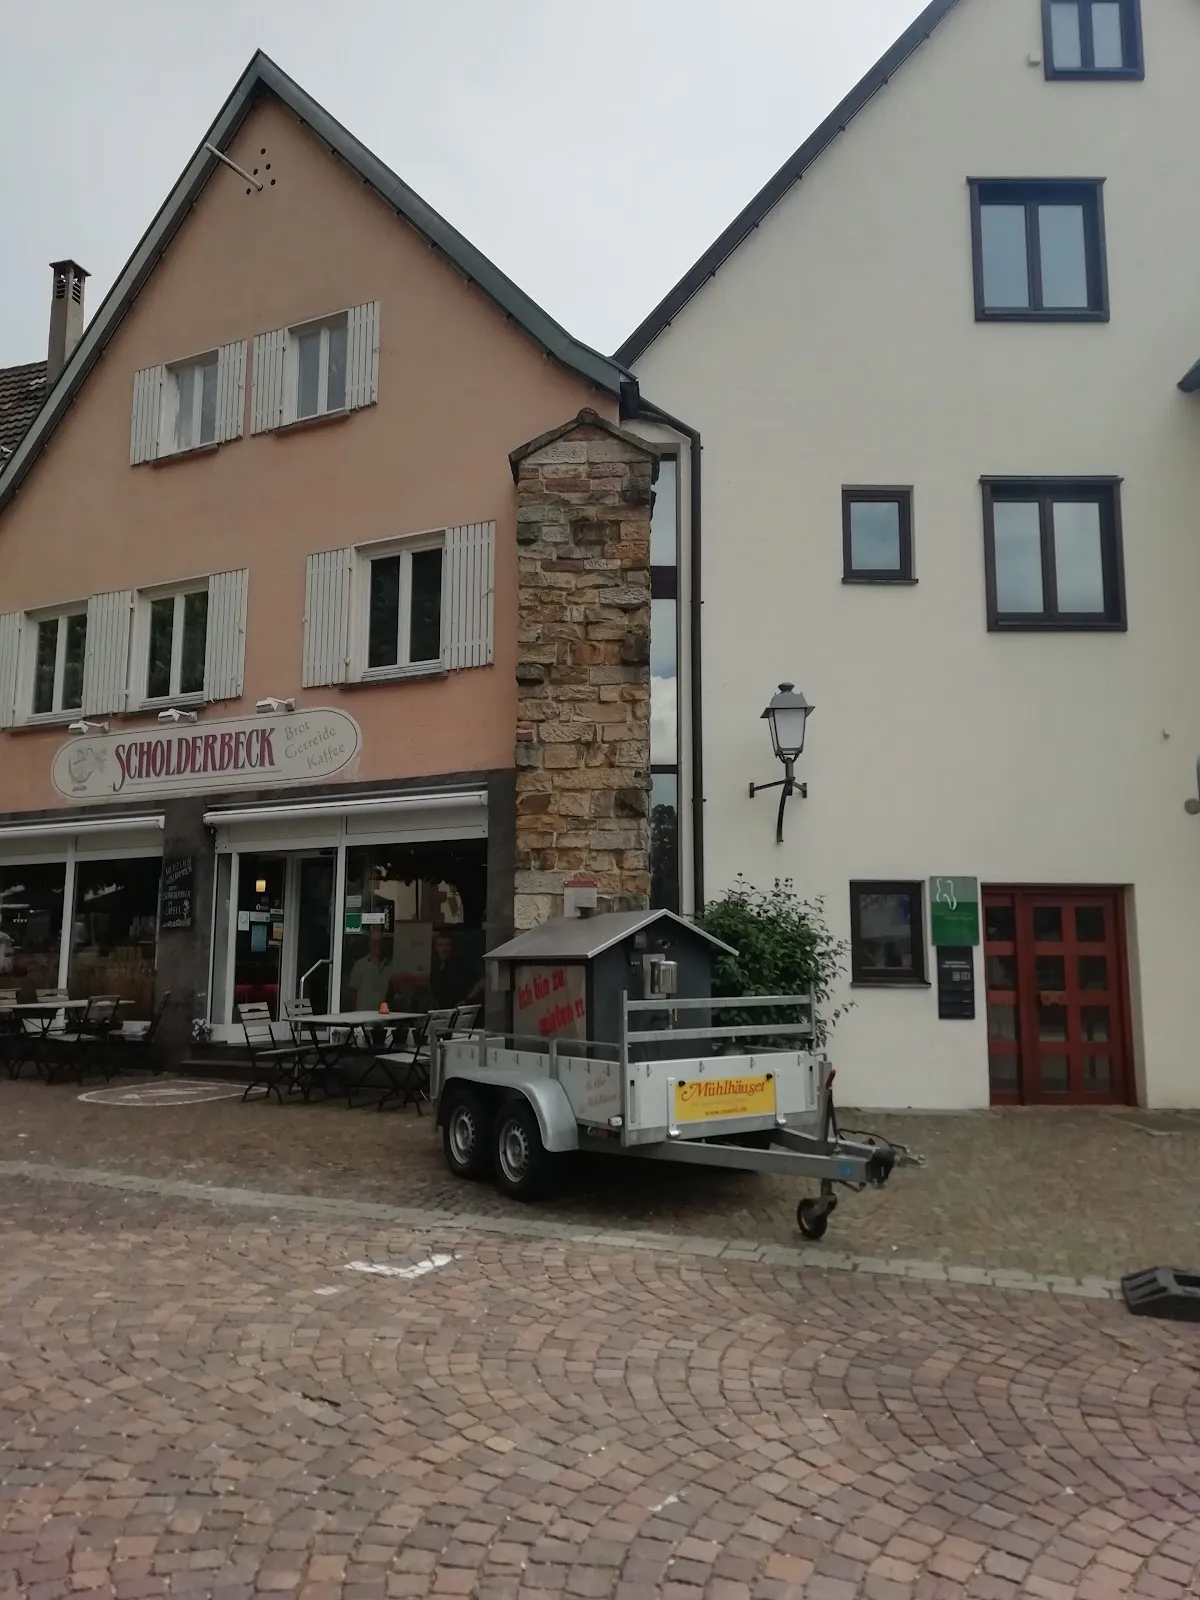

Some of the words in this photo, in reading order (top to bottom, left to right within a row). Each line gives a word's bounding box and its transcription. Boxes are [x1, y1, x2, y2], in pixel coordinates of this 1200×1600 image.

[284, 720, 310, 741] Brot
[284, 725, 337, 759] Getreide
[112, 727, 276, 792] SCHOLDERBECK
[306, 742, 346, 770] Kaffee
[518, 983, 533, 1010] Ich
[533, 974, 550, 1000] bin
[552, 969, 565, 991] zu
[681, 1079, 767, 1102] Mühlhäuser
